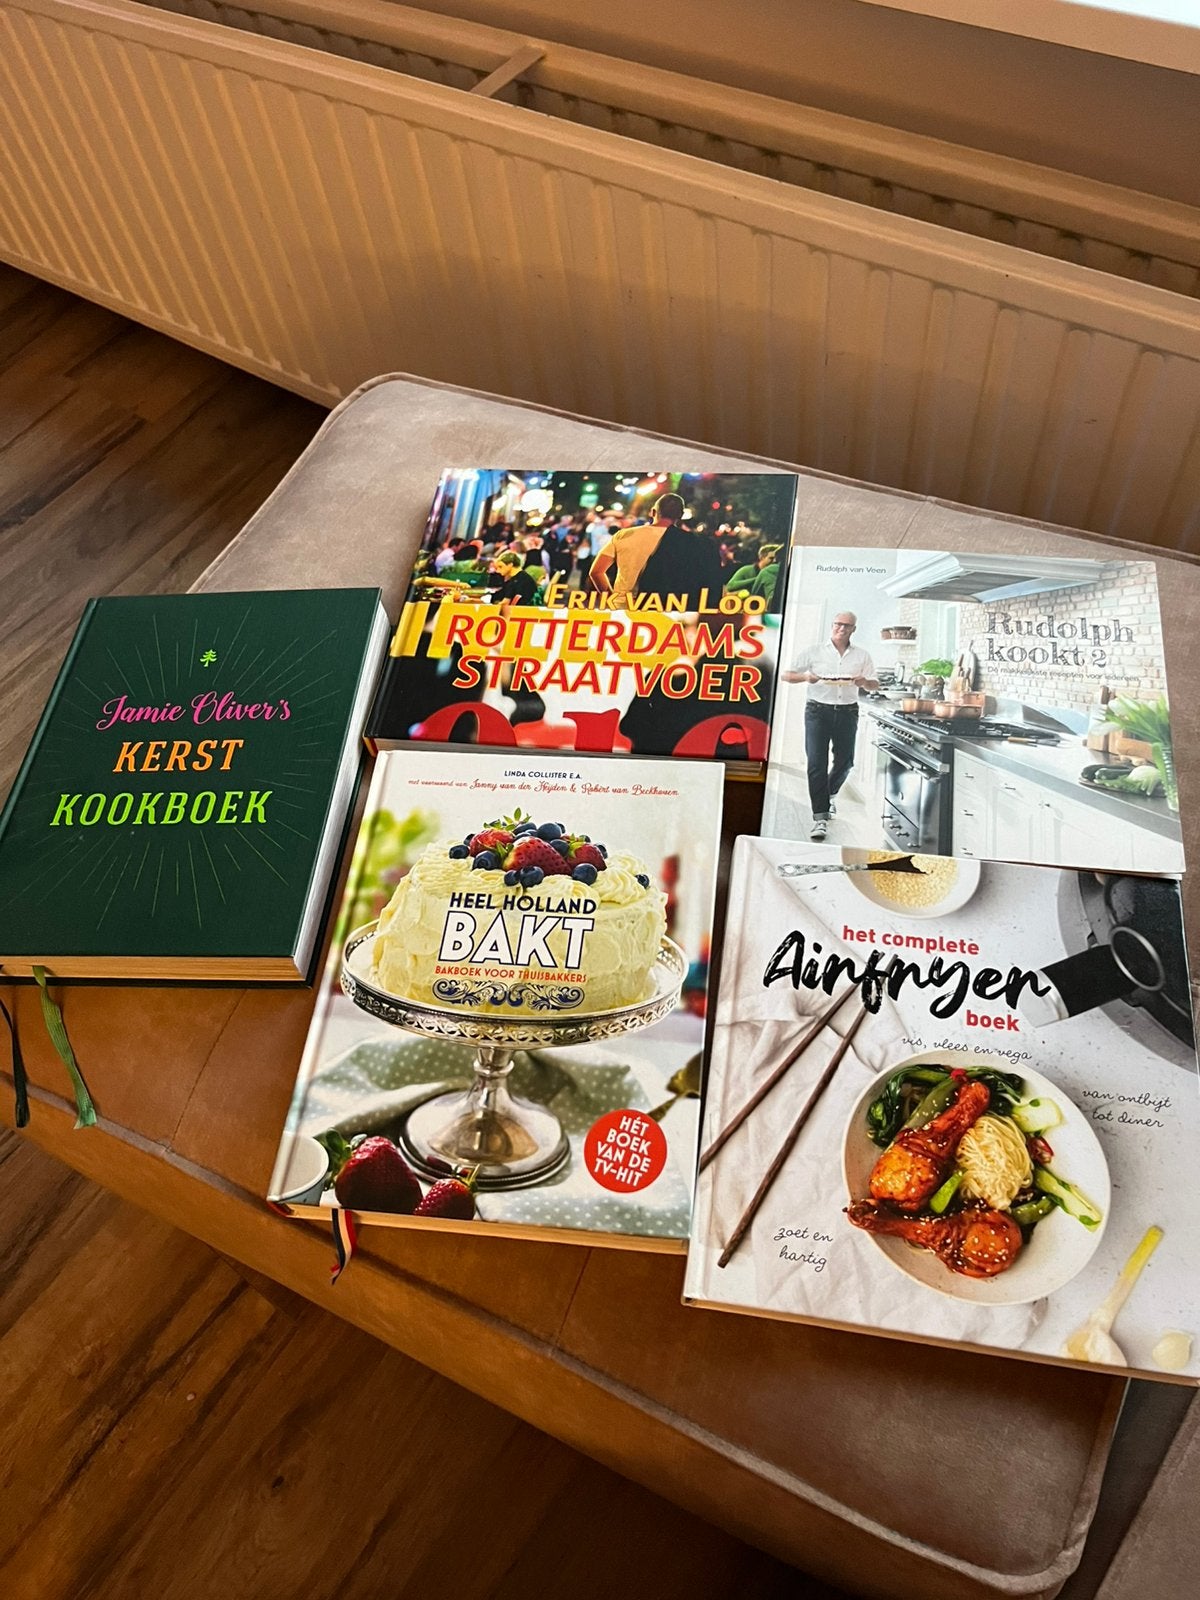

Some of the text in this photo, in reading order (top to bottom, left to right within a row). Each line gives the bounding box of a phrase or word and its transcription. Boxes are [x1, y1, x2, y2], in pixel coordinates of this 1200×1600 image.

[816, 565, 847, 573] Rudolph
[546, 583, 767, 616] ERIK VAN LOO
[444, 614, 766, 660] ROTTERDAMS
[983, 611, 1136, 647] Rudolph
[984, 638, 1107, 668] kookt 2
[452, 653, 761, 703] STRAATVOER
[96, 691, 291, 731] Jamie Oliver's
[112, 739, 245, 773] KERST
[528, 771, 567, 779] COLLISTER
[50, 790, 274, 826] KOOKBOEK
[451, 892, 597, 915] HEEL HOLLAND
[438, 909, 595, 969] BAKT
[842, 925, 980, 956] het complete
[435, 965, 587, 982] BAKBOEK VOOR THUISBAKKERS
[762, 930, 1052, 1019] Airfryer
[966, 1010, 1020, 1032] boek
[934, 1039, 969, 1051] vlees
[974, 1045, 993, 1054] en
[997, 1048, 1033, 1064] vega
[1082, 1090, 1172, 1112] van ontbijt
[619, 1115, 650, 1137] HÉT
[1092, 1107, 1164, 1127] tot diner
[606, 1128, 651, 1156] BOEK
[597, 1141, 651, 1173] VAN DE
[594, 1158, 643, 1187] TV-HIT
[773, 1227, 834, 1242] zoet en
[779, 1245, 827, 1273] hartig
